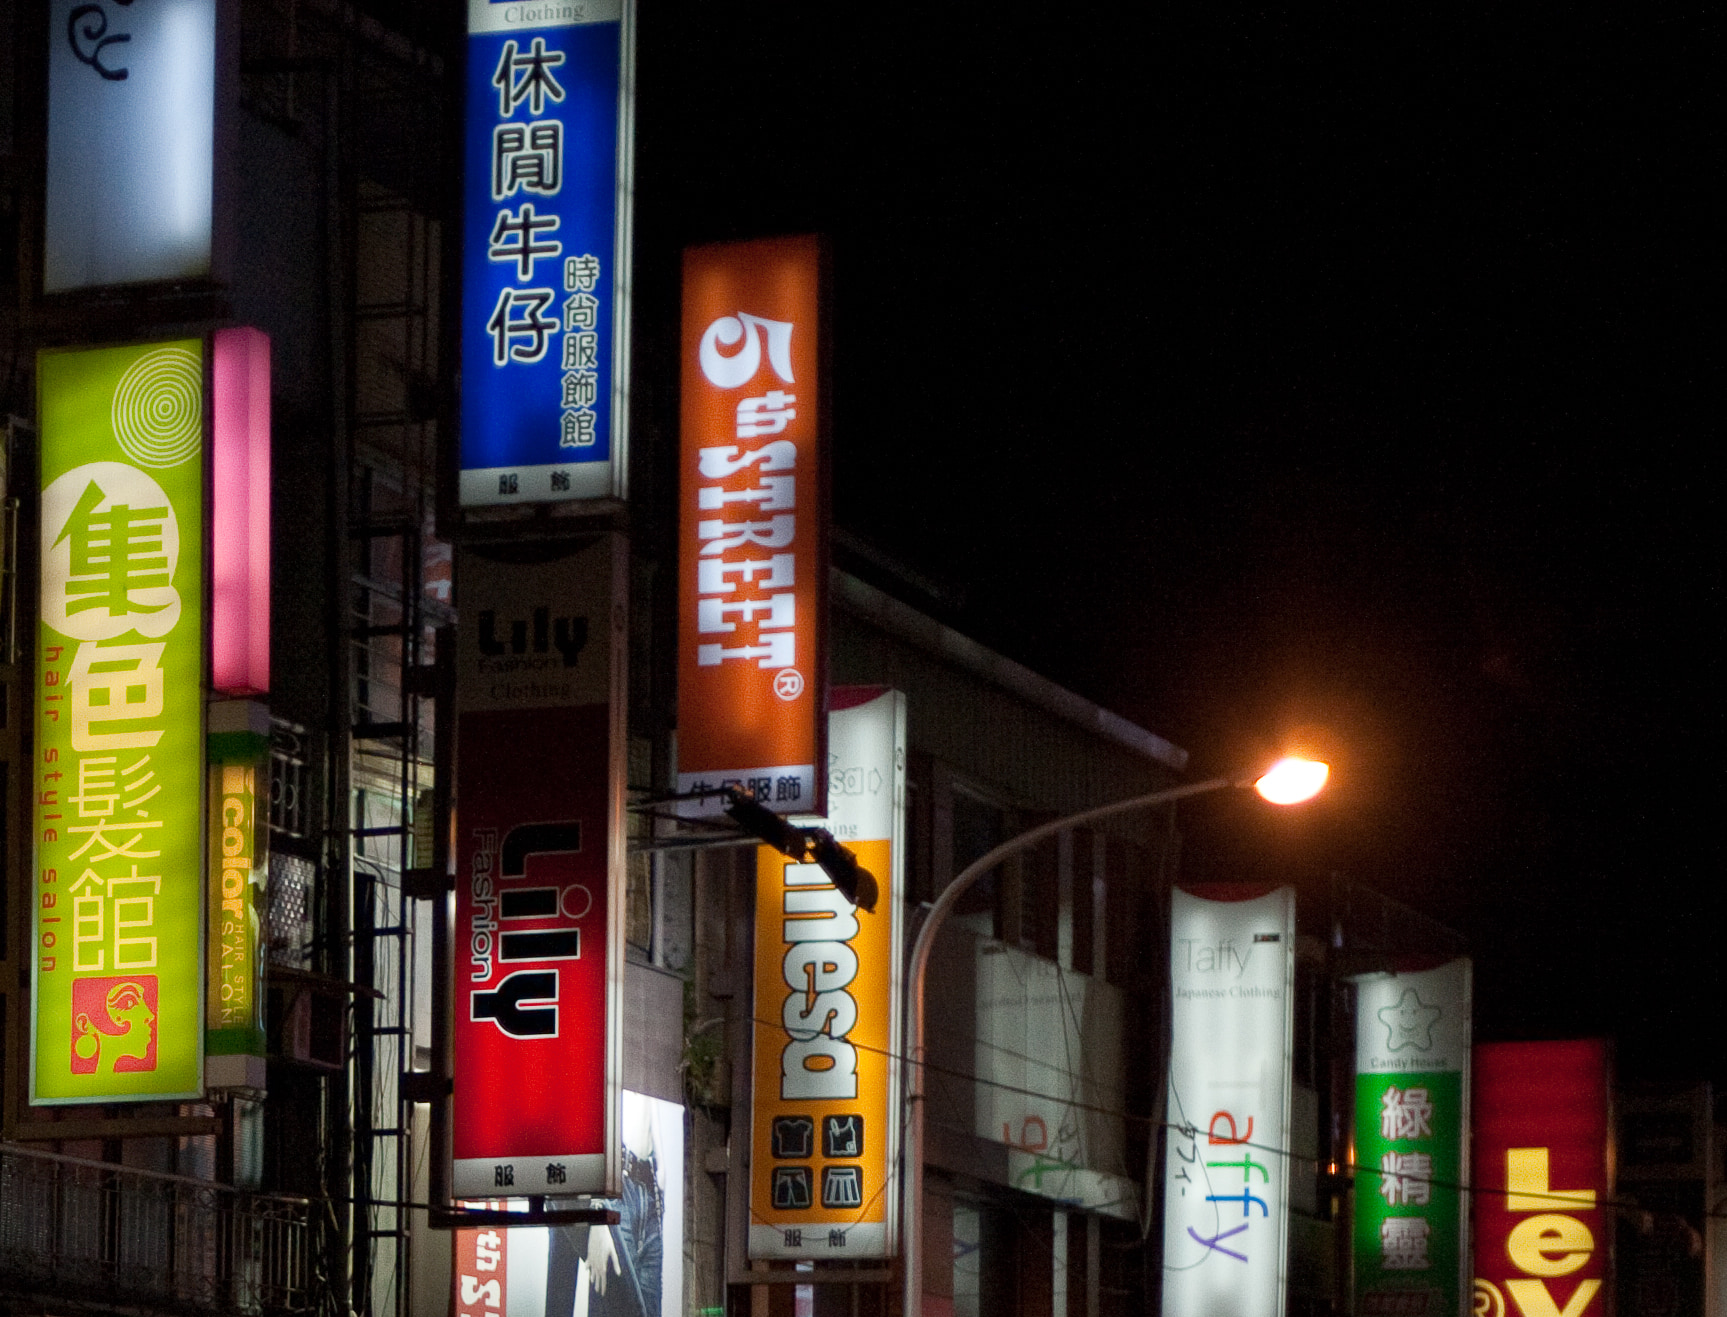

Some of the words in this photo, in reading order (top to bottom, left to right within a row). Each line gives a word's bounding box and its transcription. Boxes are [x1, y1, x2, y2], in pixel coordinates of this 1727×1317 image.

[559, 253, 601, 451] 時尚服飾館
[699, 310, 797, 439] 5th
[498, 468, 571, 496] 服飾
[698, 439, 797, 668] STREET
[44, 644, 64, 722] hair
[39, 748, 63, 844] style
[40, 868, 62, 974] salon
[470, 819, 593, 1040] Lily
[471, 827, 498, 983] Fashion
[495, 1163, 567, 1188] 服飾
